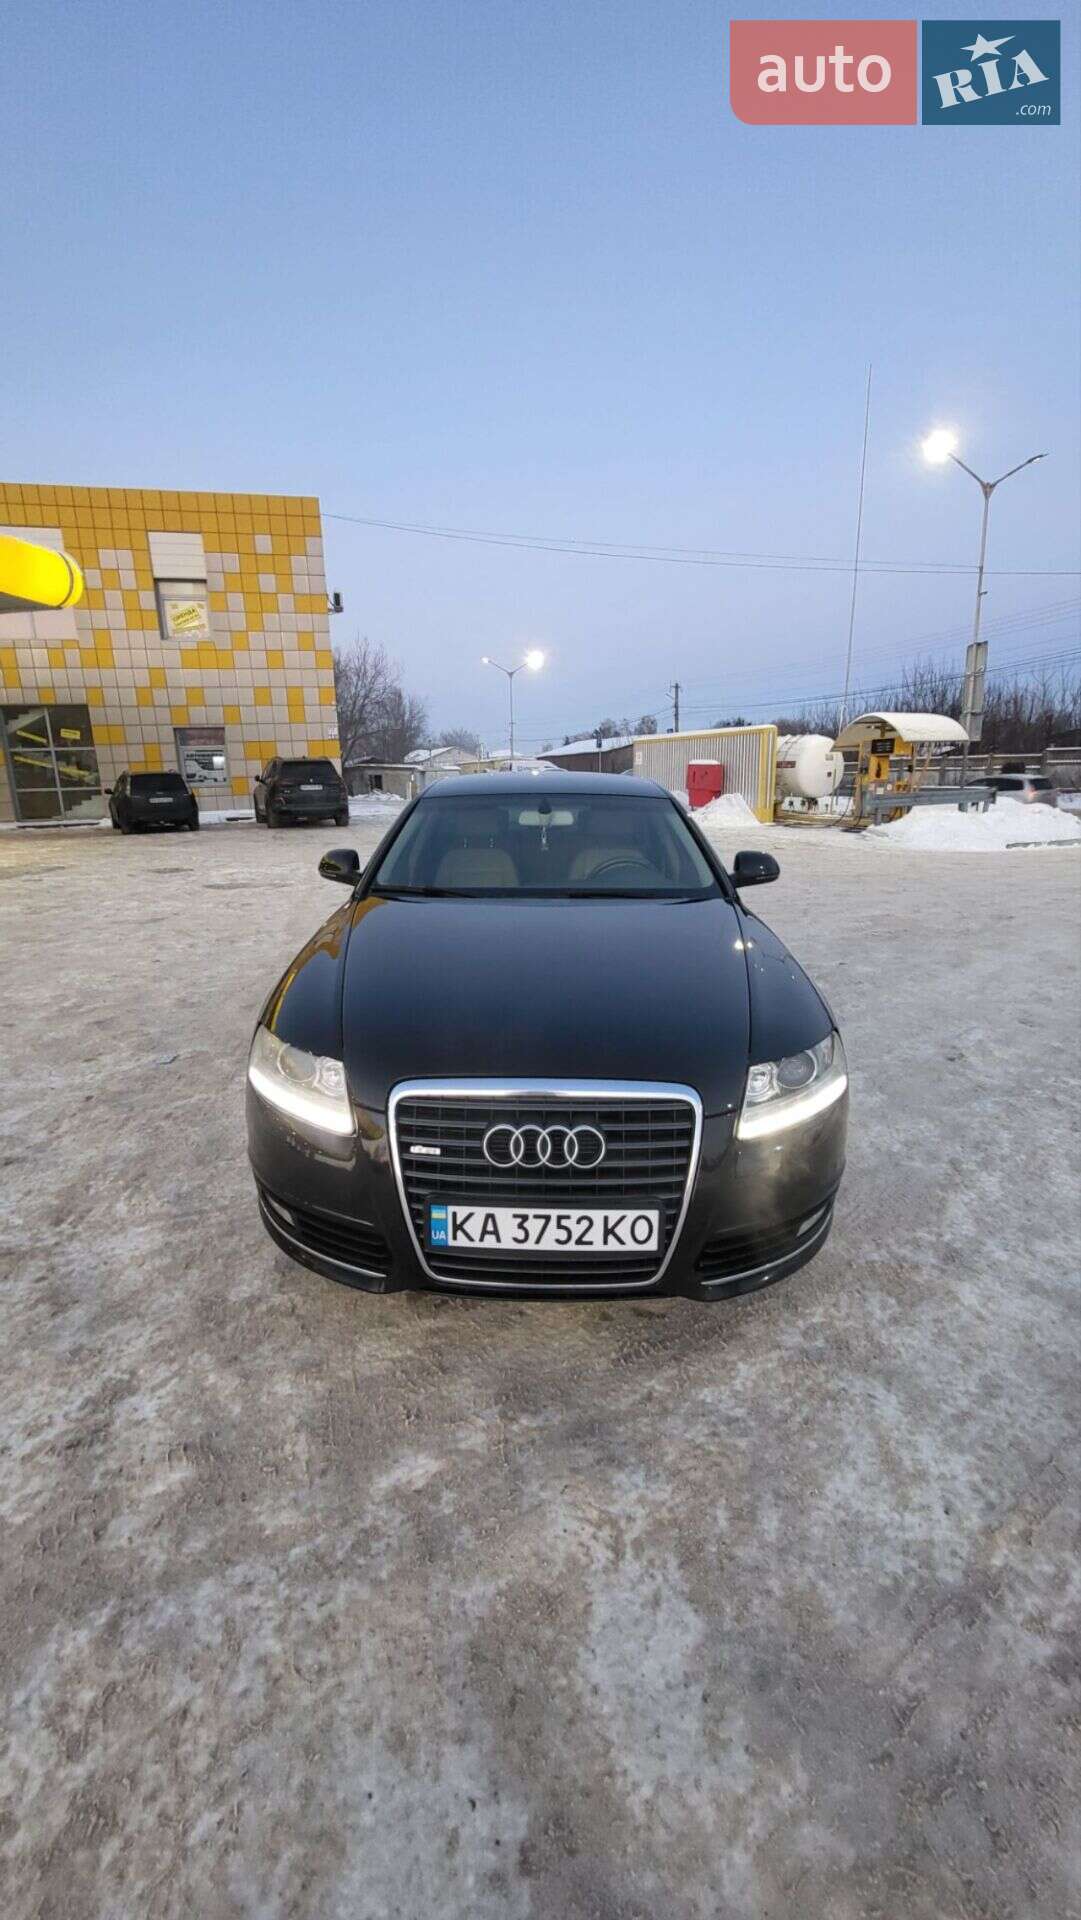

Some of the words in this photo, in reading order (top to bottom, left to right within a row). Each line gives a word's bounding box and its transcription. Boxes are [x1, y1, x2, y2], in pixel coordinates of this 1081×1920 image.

[431, 1230, 446, 1240] UA
[452, 1211, 502, 1244] KA
[511, 1214, 594, 1246] 3752
[602, 1215, 654, 1246] KO
